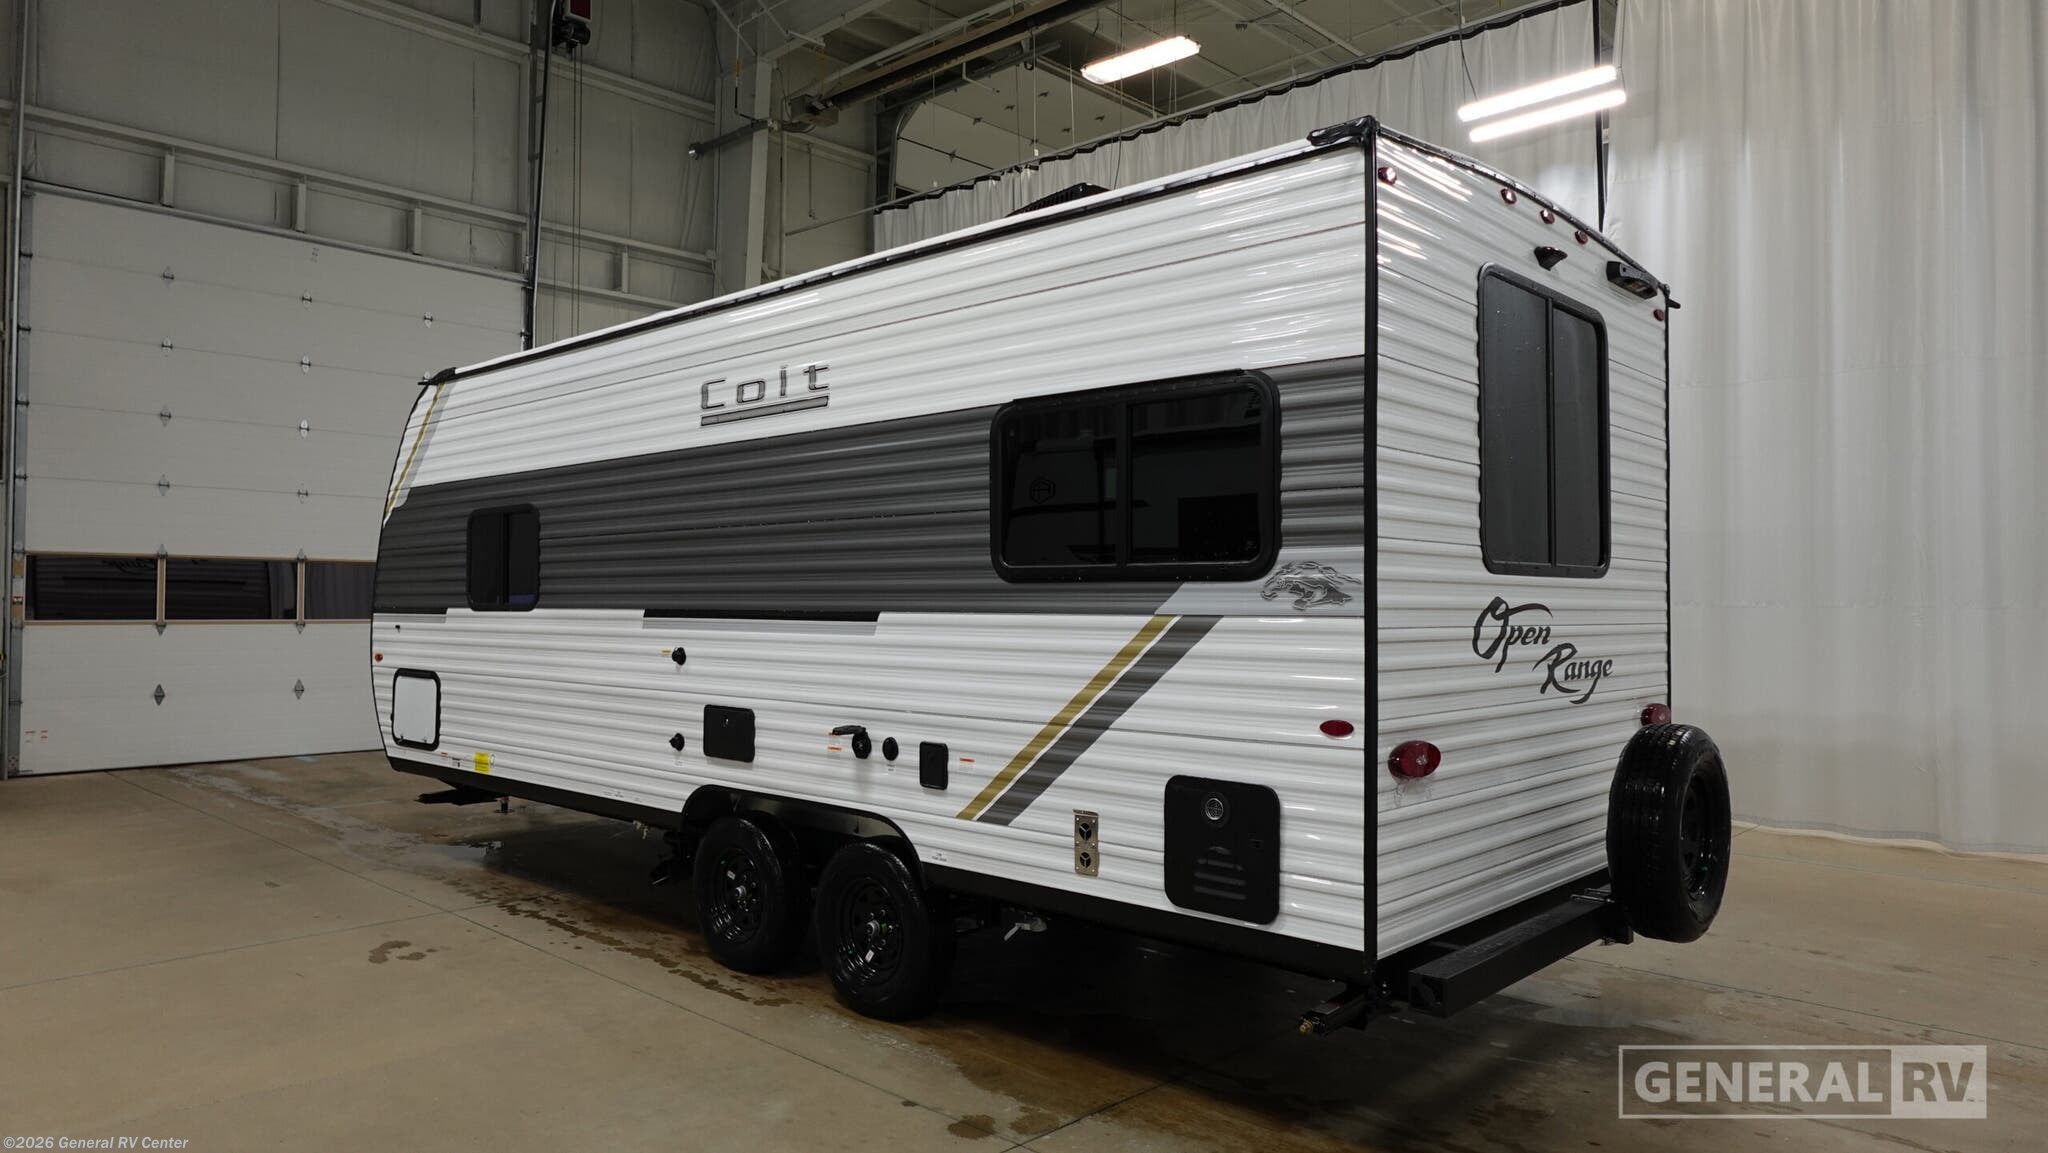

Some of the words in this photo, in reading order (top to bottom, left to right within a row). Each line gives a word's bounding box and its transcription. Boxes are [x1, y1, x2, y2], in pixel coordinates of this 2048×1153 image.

[701, 365, 829, 410] Colt
[1472, 596, 1553, 673] Open
[1532, 643, 1613, 704] Range
